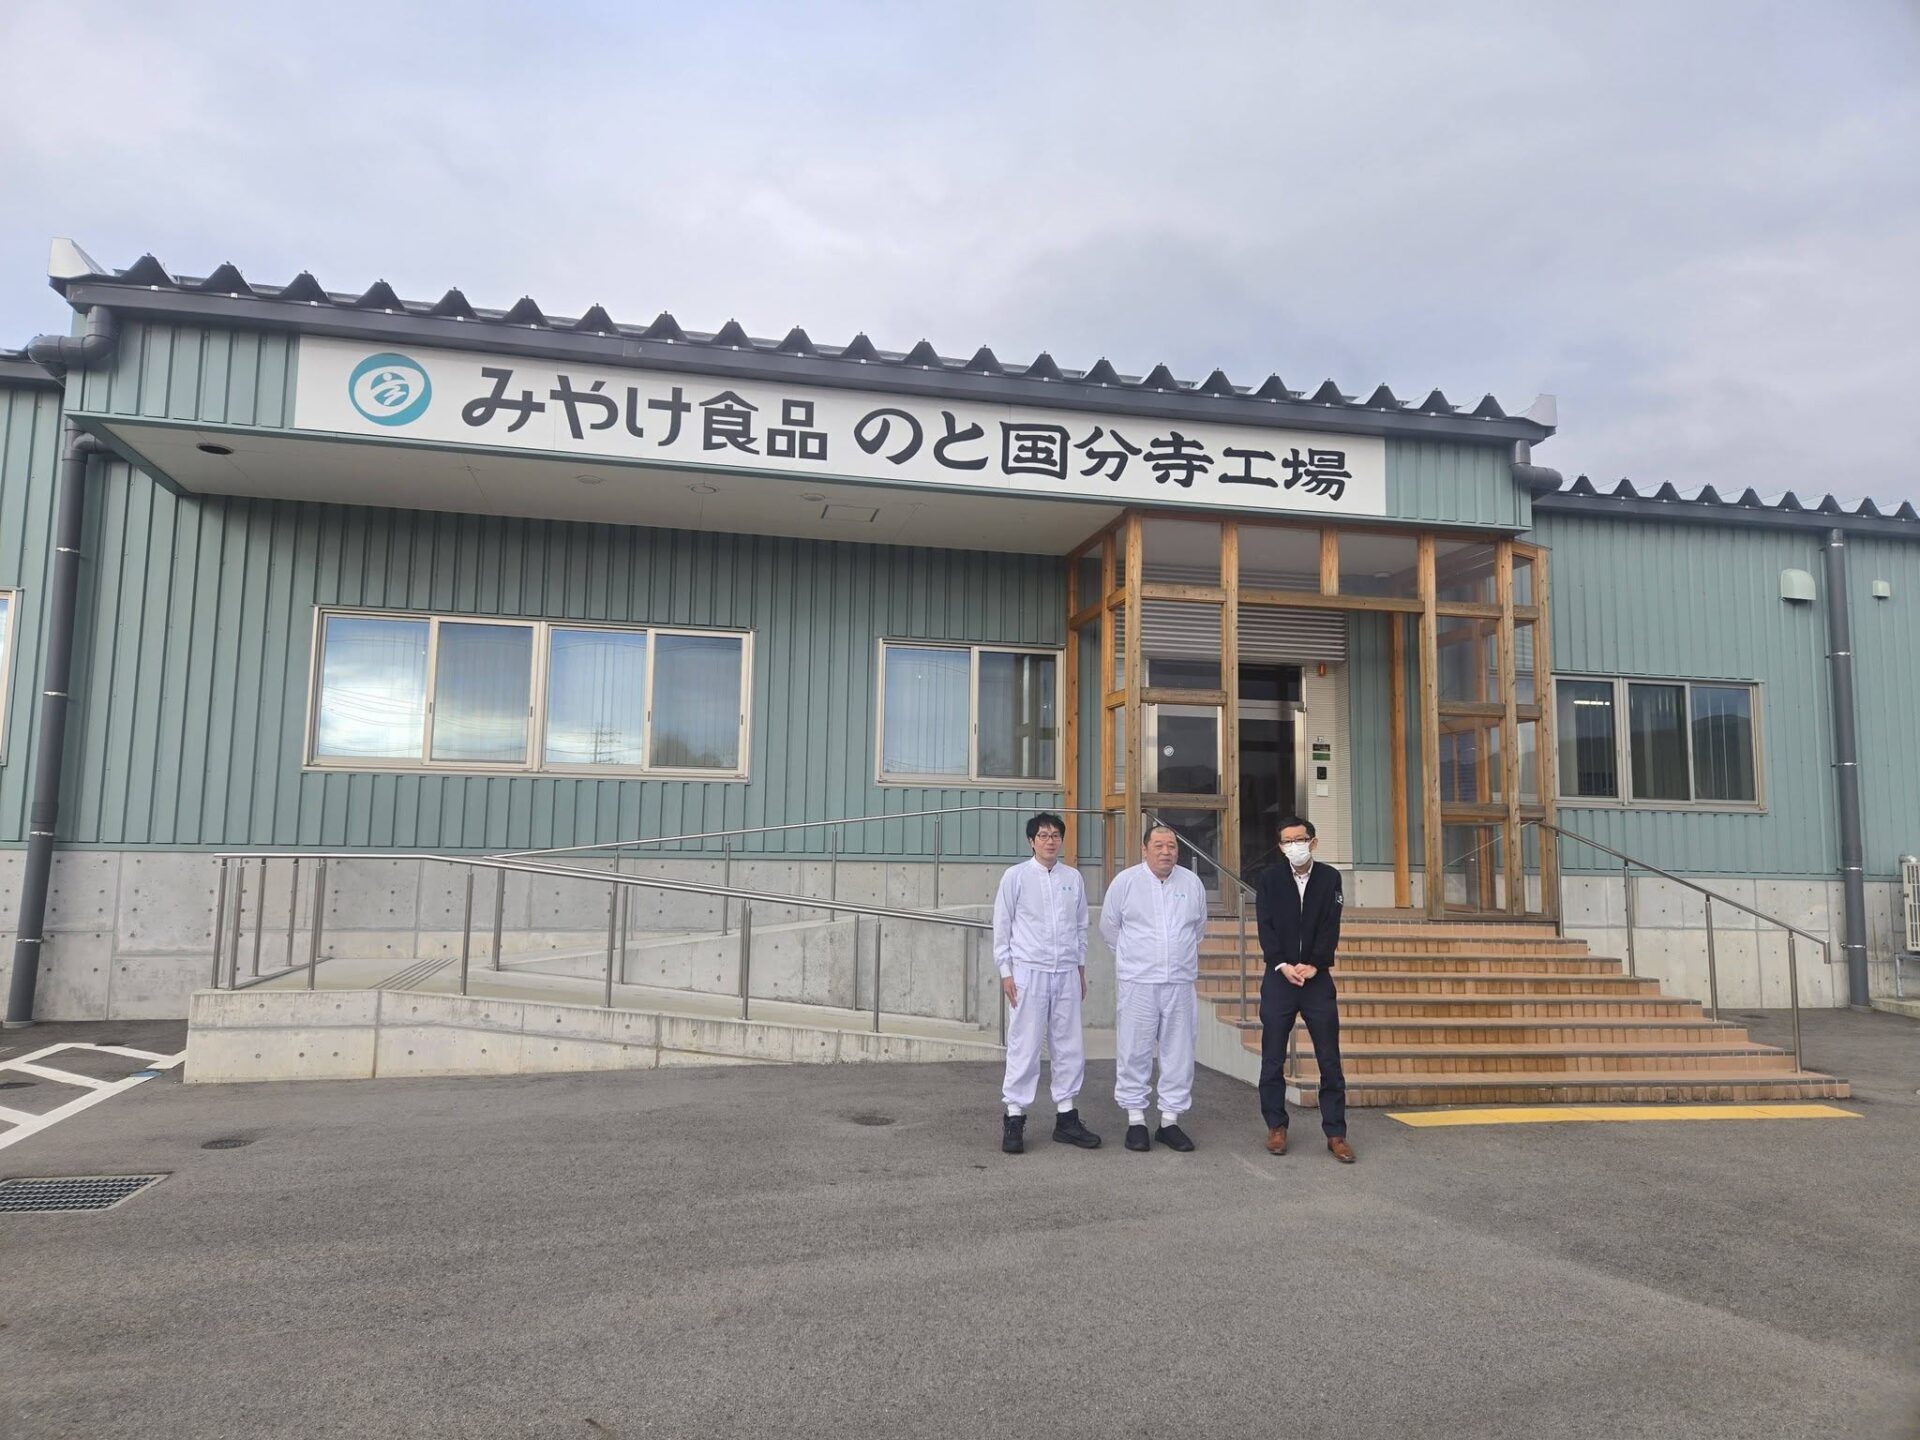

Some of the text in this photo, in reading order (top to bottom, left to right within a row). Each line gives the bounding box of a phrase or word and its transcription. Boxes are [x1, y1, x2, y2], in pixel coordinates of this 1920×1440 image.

[462, 367, 1354, 502] みやけ食品 のと国分寺工場
